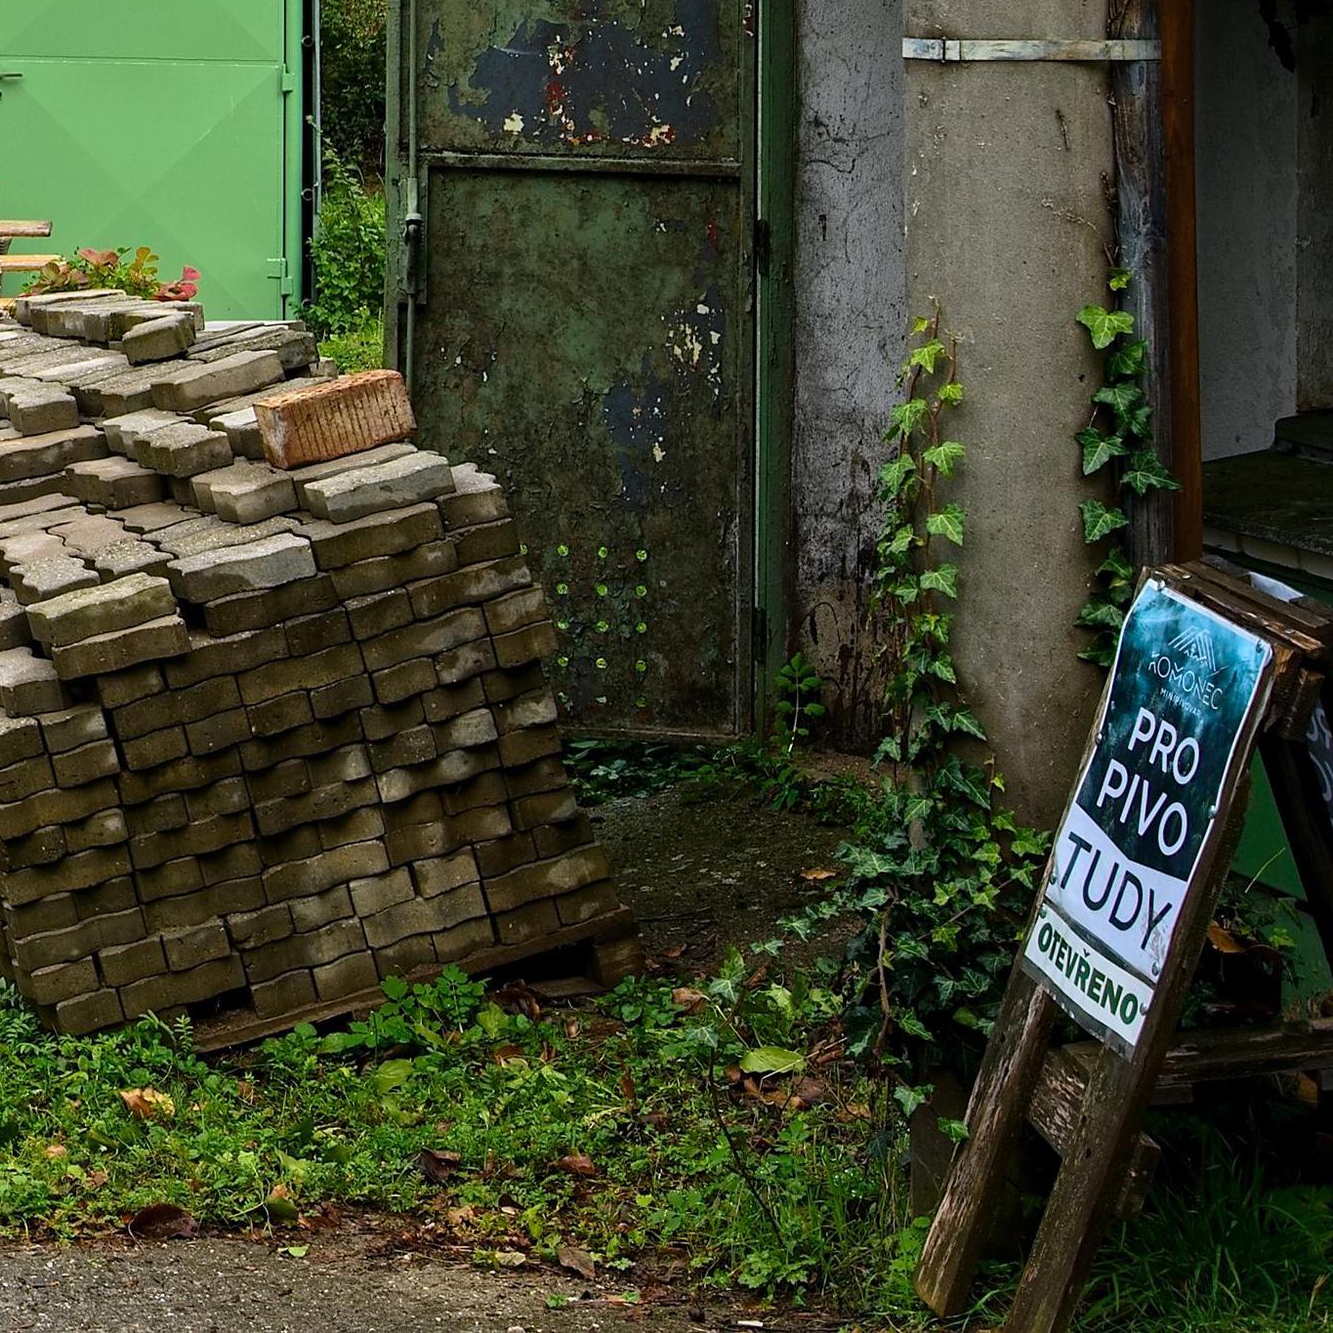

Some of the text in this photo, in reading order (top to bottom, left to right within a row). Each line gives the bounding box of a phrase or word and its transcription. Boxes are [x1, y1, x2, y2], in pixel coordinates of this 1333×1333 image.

[1147, 651, 1223, 710] KOMONEC
[1127, 706, 1200, 786] PRO
[1096, 758, 1188, 857] PIVO
[1058, 831, 1172, 952] TUDY
[1037, 922, 1139, 1026] OTEVŘENO
